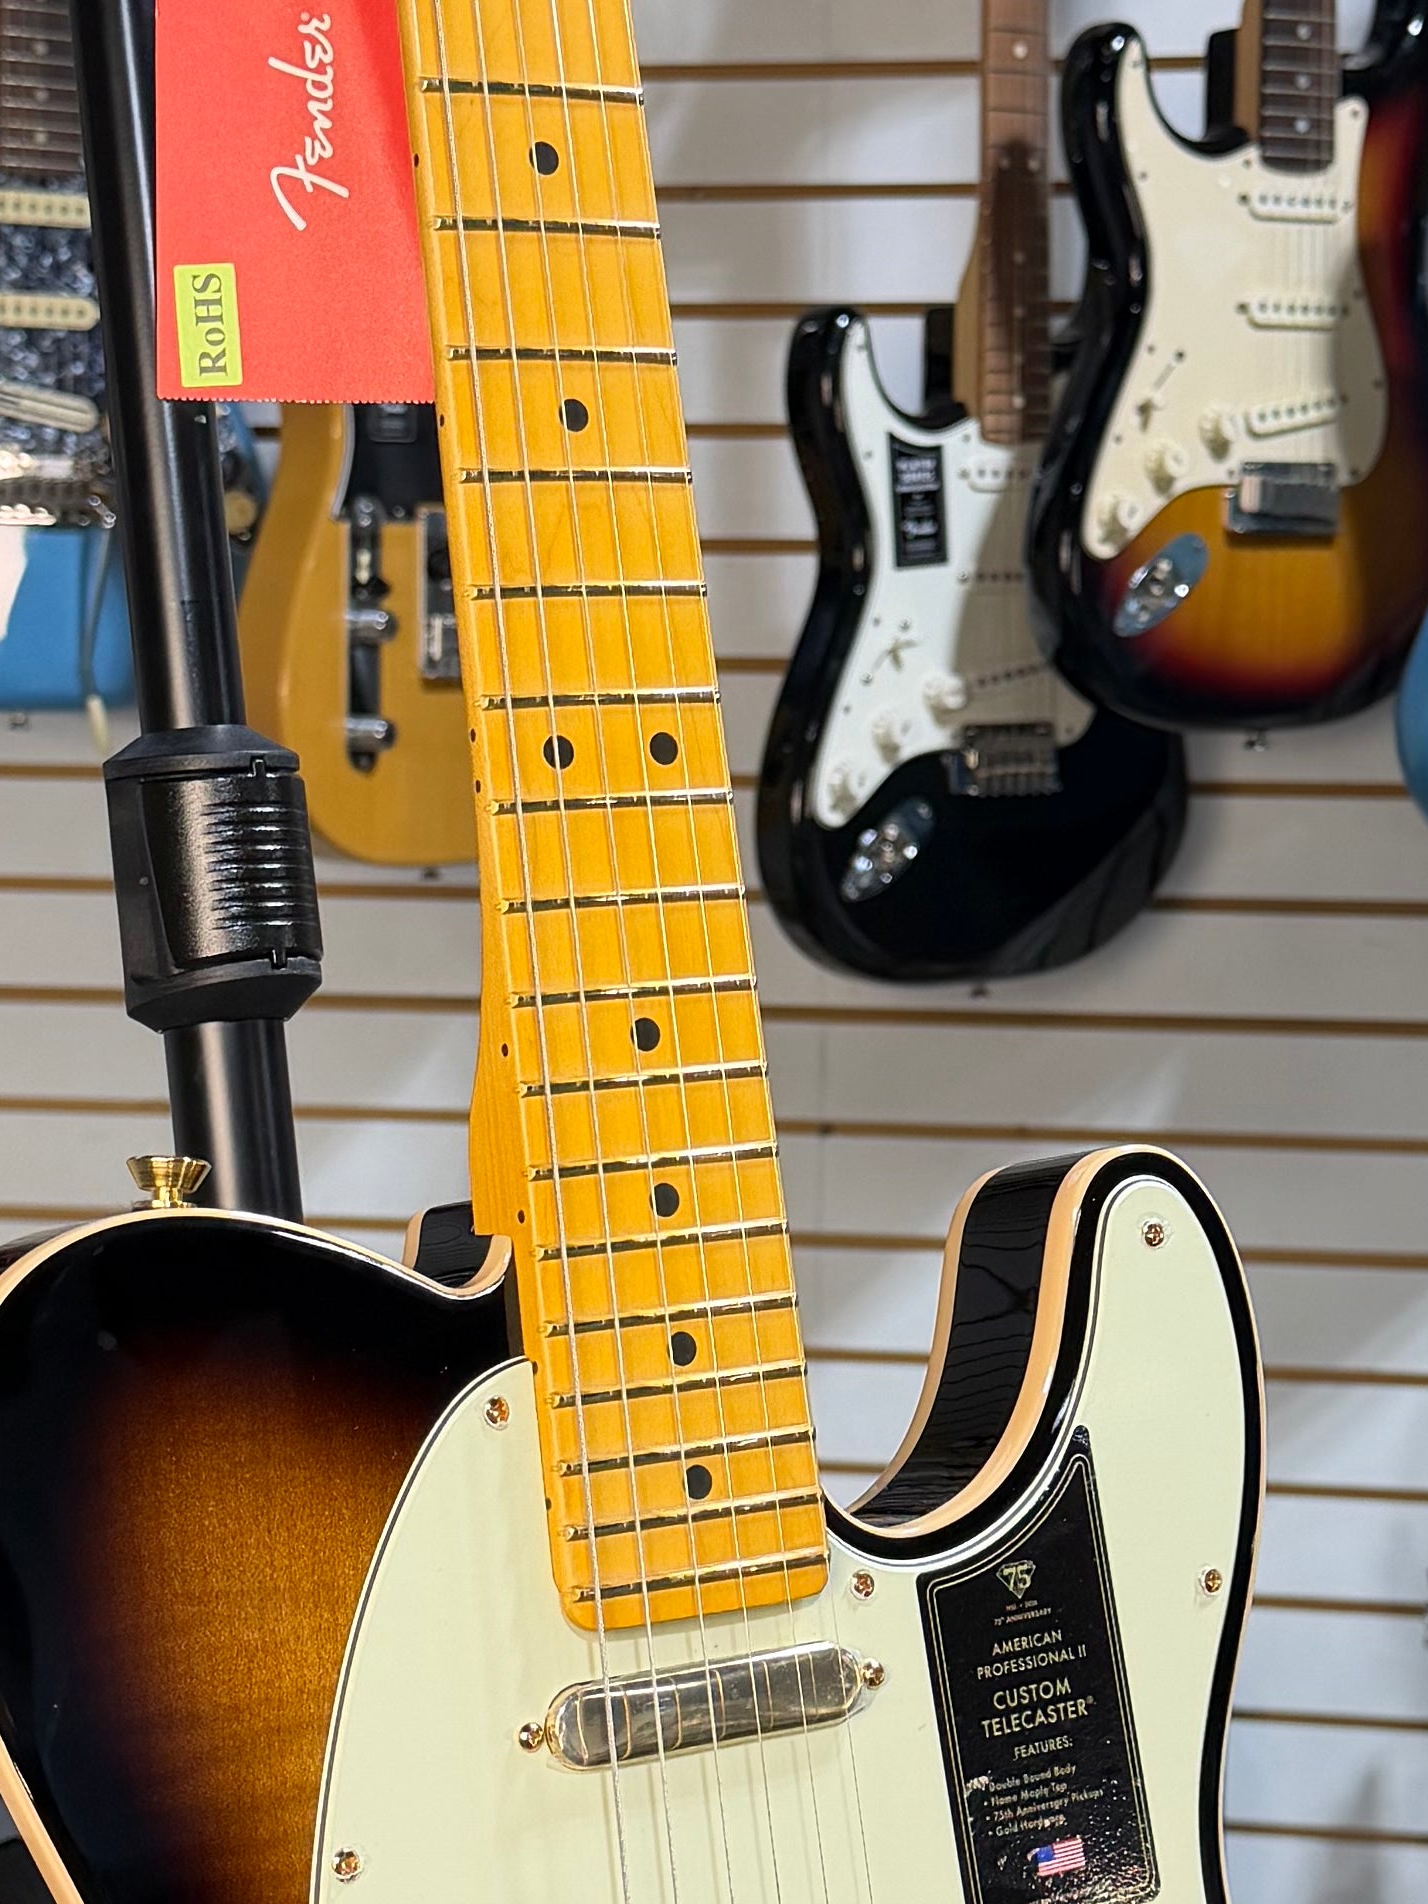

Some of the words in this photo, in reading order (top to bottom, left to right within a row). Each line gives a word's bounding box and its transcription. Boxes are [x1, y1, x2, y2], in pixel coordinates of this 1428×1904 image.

[268, 10, 350, 231] Fender
[191, 271, 228, 378] RoHS
[1002, 1563, 1032, 1591] 75
[992, 1629, 1062, 1656] AMERICAN
[977, 1647, 1075, 1680] PROFESSIONAL
[1077, 1644, 1087, 1658] II
[993, 1677, 1071, 1709] CUSTOM
[1013, 1735, 1074, 1761] FEATURES:
[988, 1778, 1021, 1793] Double
[1053, 1762, 1077, 1777] Body
[993, 1809, 1014, 1823] 75th
[1016, 1796, 1069, 1817] Anniversary
[1071, 1788, 1105, 1803] Pickups
[995, 1822, 1019, 1836] Gold
